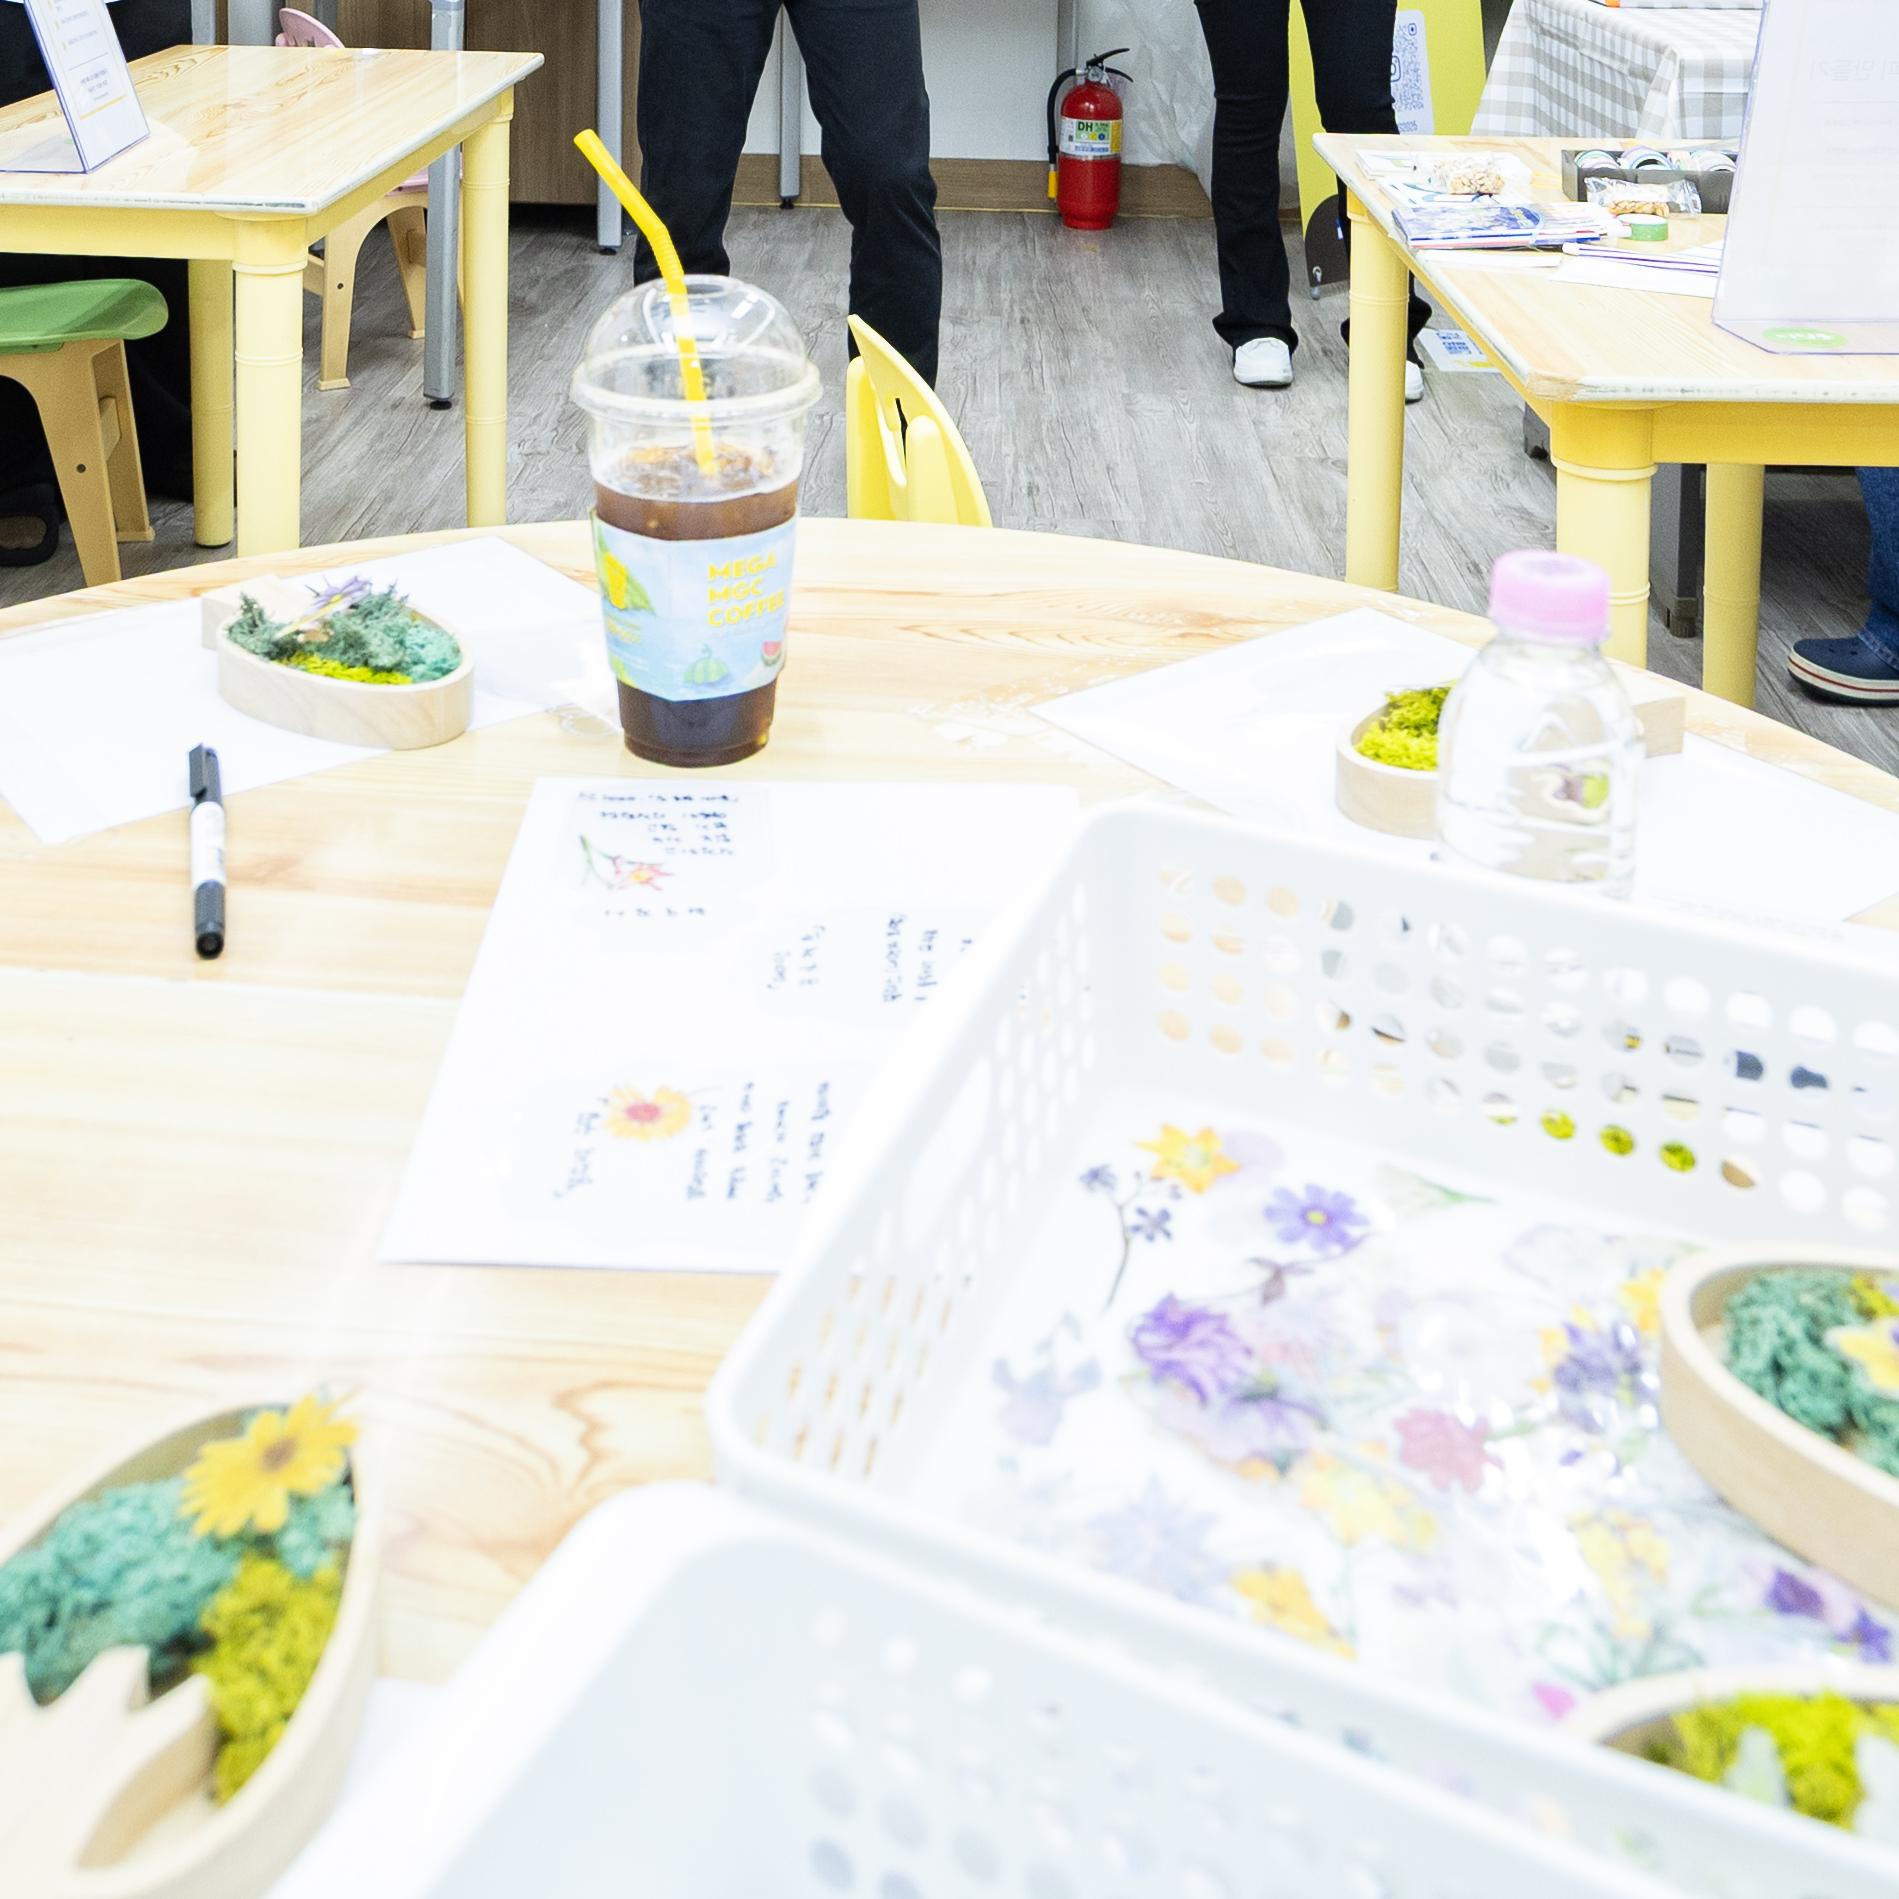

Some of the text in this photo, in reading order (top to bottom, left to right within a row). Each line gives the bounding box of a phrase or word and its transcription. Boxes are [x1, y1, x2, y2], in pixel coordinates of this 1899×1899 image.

[1077, 121, 1093, 131] DH
[708, 551, 777, 581] MEGA
[708, 576, 765, 604] MGC
[707, 588, 785, 627] COFFEE
